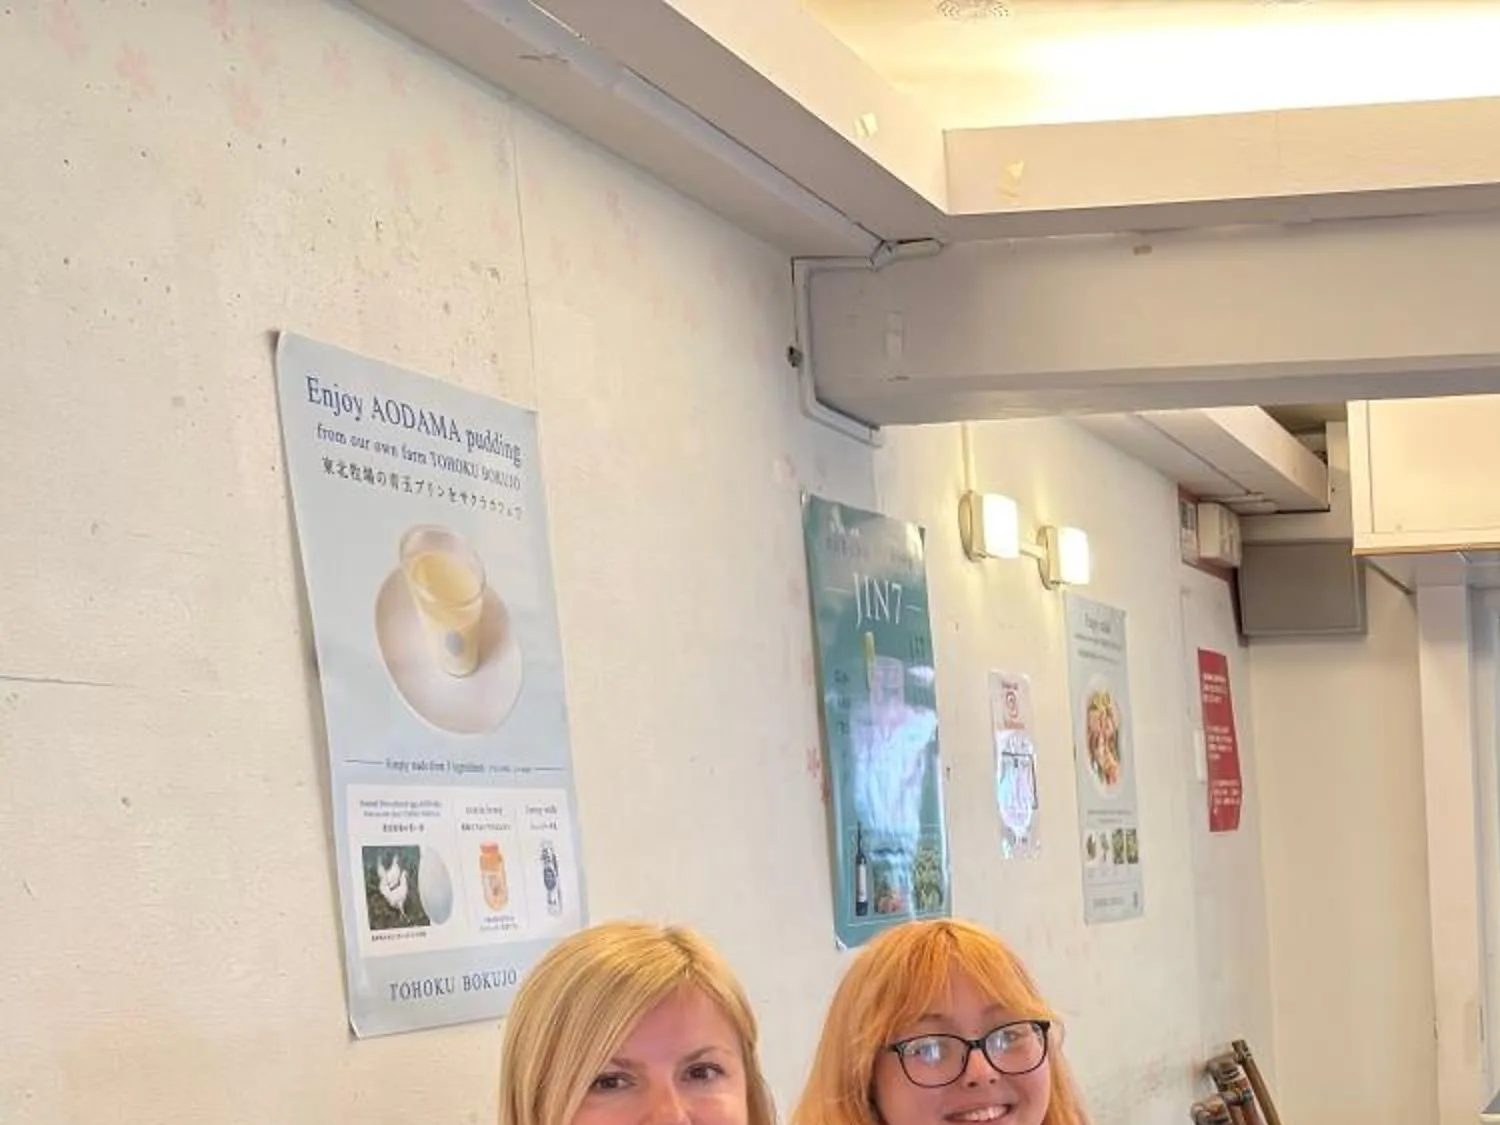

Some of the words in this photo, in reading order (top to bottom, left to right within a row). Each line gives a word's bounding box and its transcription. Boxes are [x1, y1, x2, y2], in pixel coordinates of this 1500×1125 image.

[306, 375, 364, 421] Enjoy
[371, 396, 461, 442] AODAMA
[466, 429, 522, 468] pudding
[317, 422, 347, 445] from
[349, 434, 371, 449] our
[374, 440, 398, 458] own
[401, 444, 427, 465] farm
[430, 451, 479, 480] TOHOKU
[389, 976, 456, 1001] TOHOKU
[462, 968, 518, 992] BOKUJO
